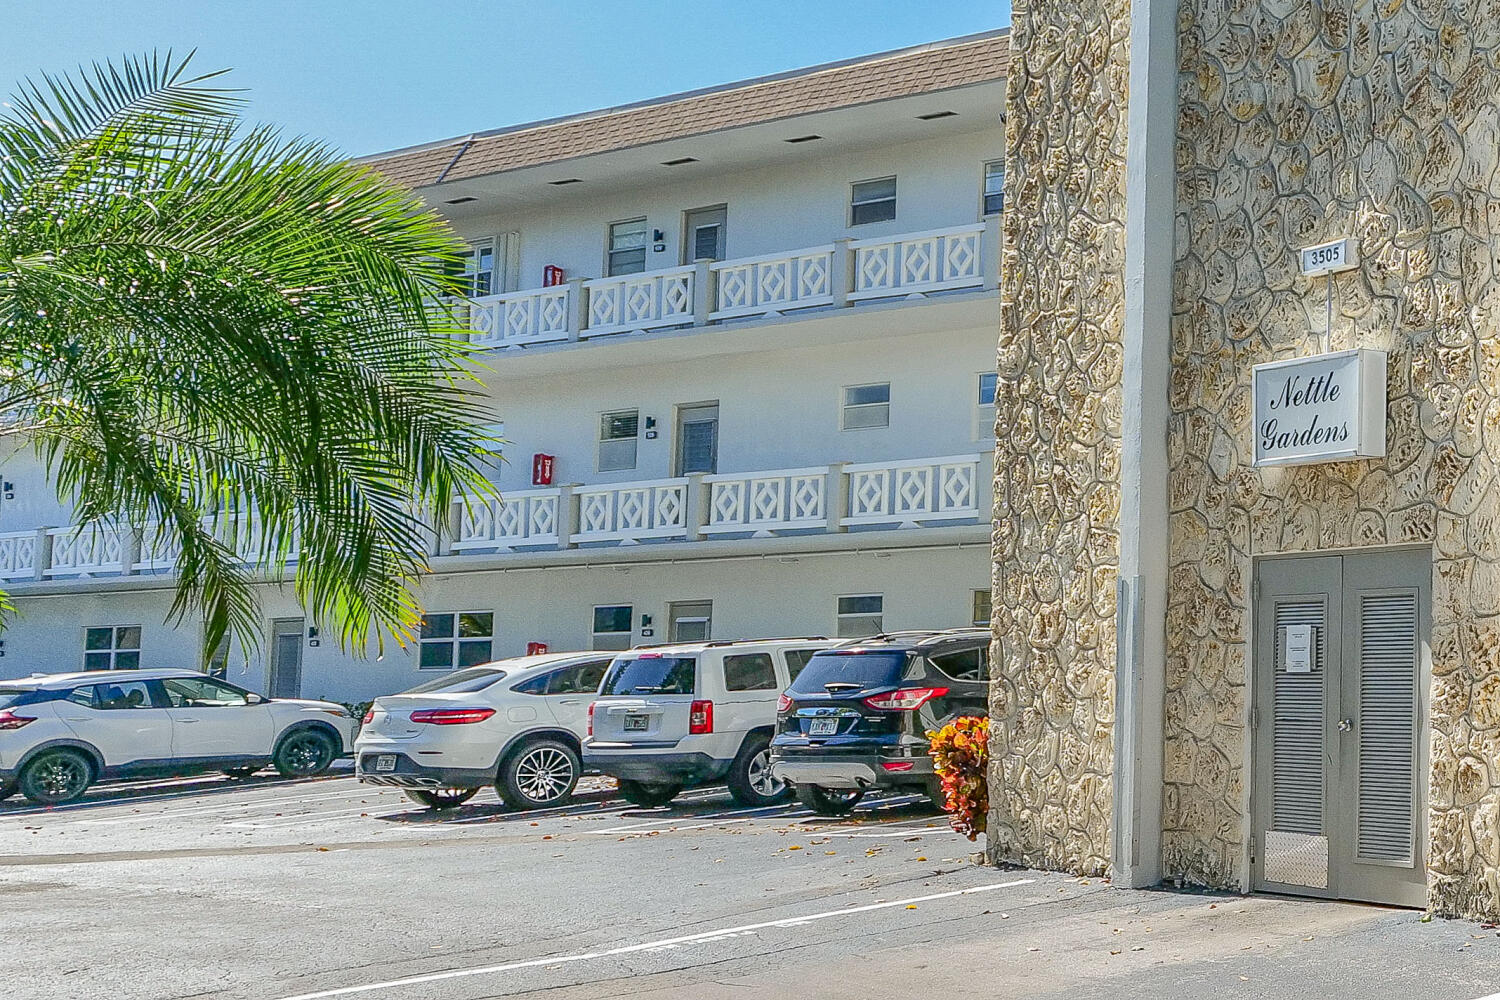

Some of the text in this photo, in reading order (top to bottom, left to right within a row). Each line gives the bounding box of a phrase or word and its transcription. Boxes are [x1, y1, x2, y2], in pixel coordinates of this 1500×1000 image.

[1311, 246, 1340, 265] 3505
[1270, 371, 1341, 410] Nettle
[1261, 414, 1349, 450] Gardens
